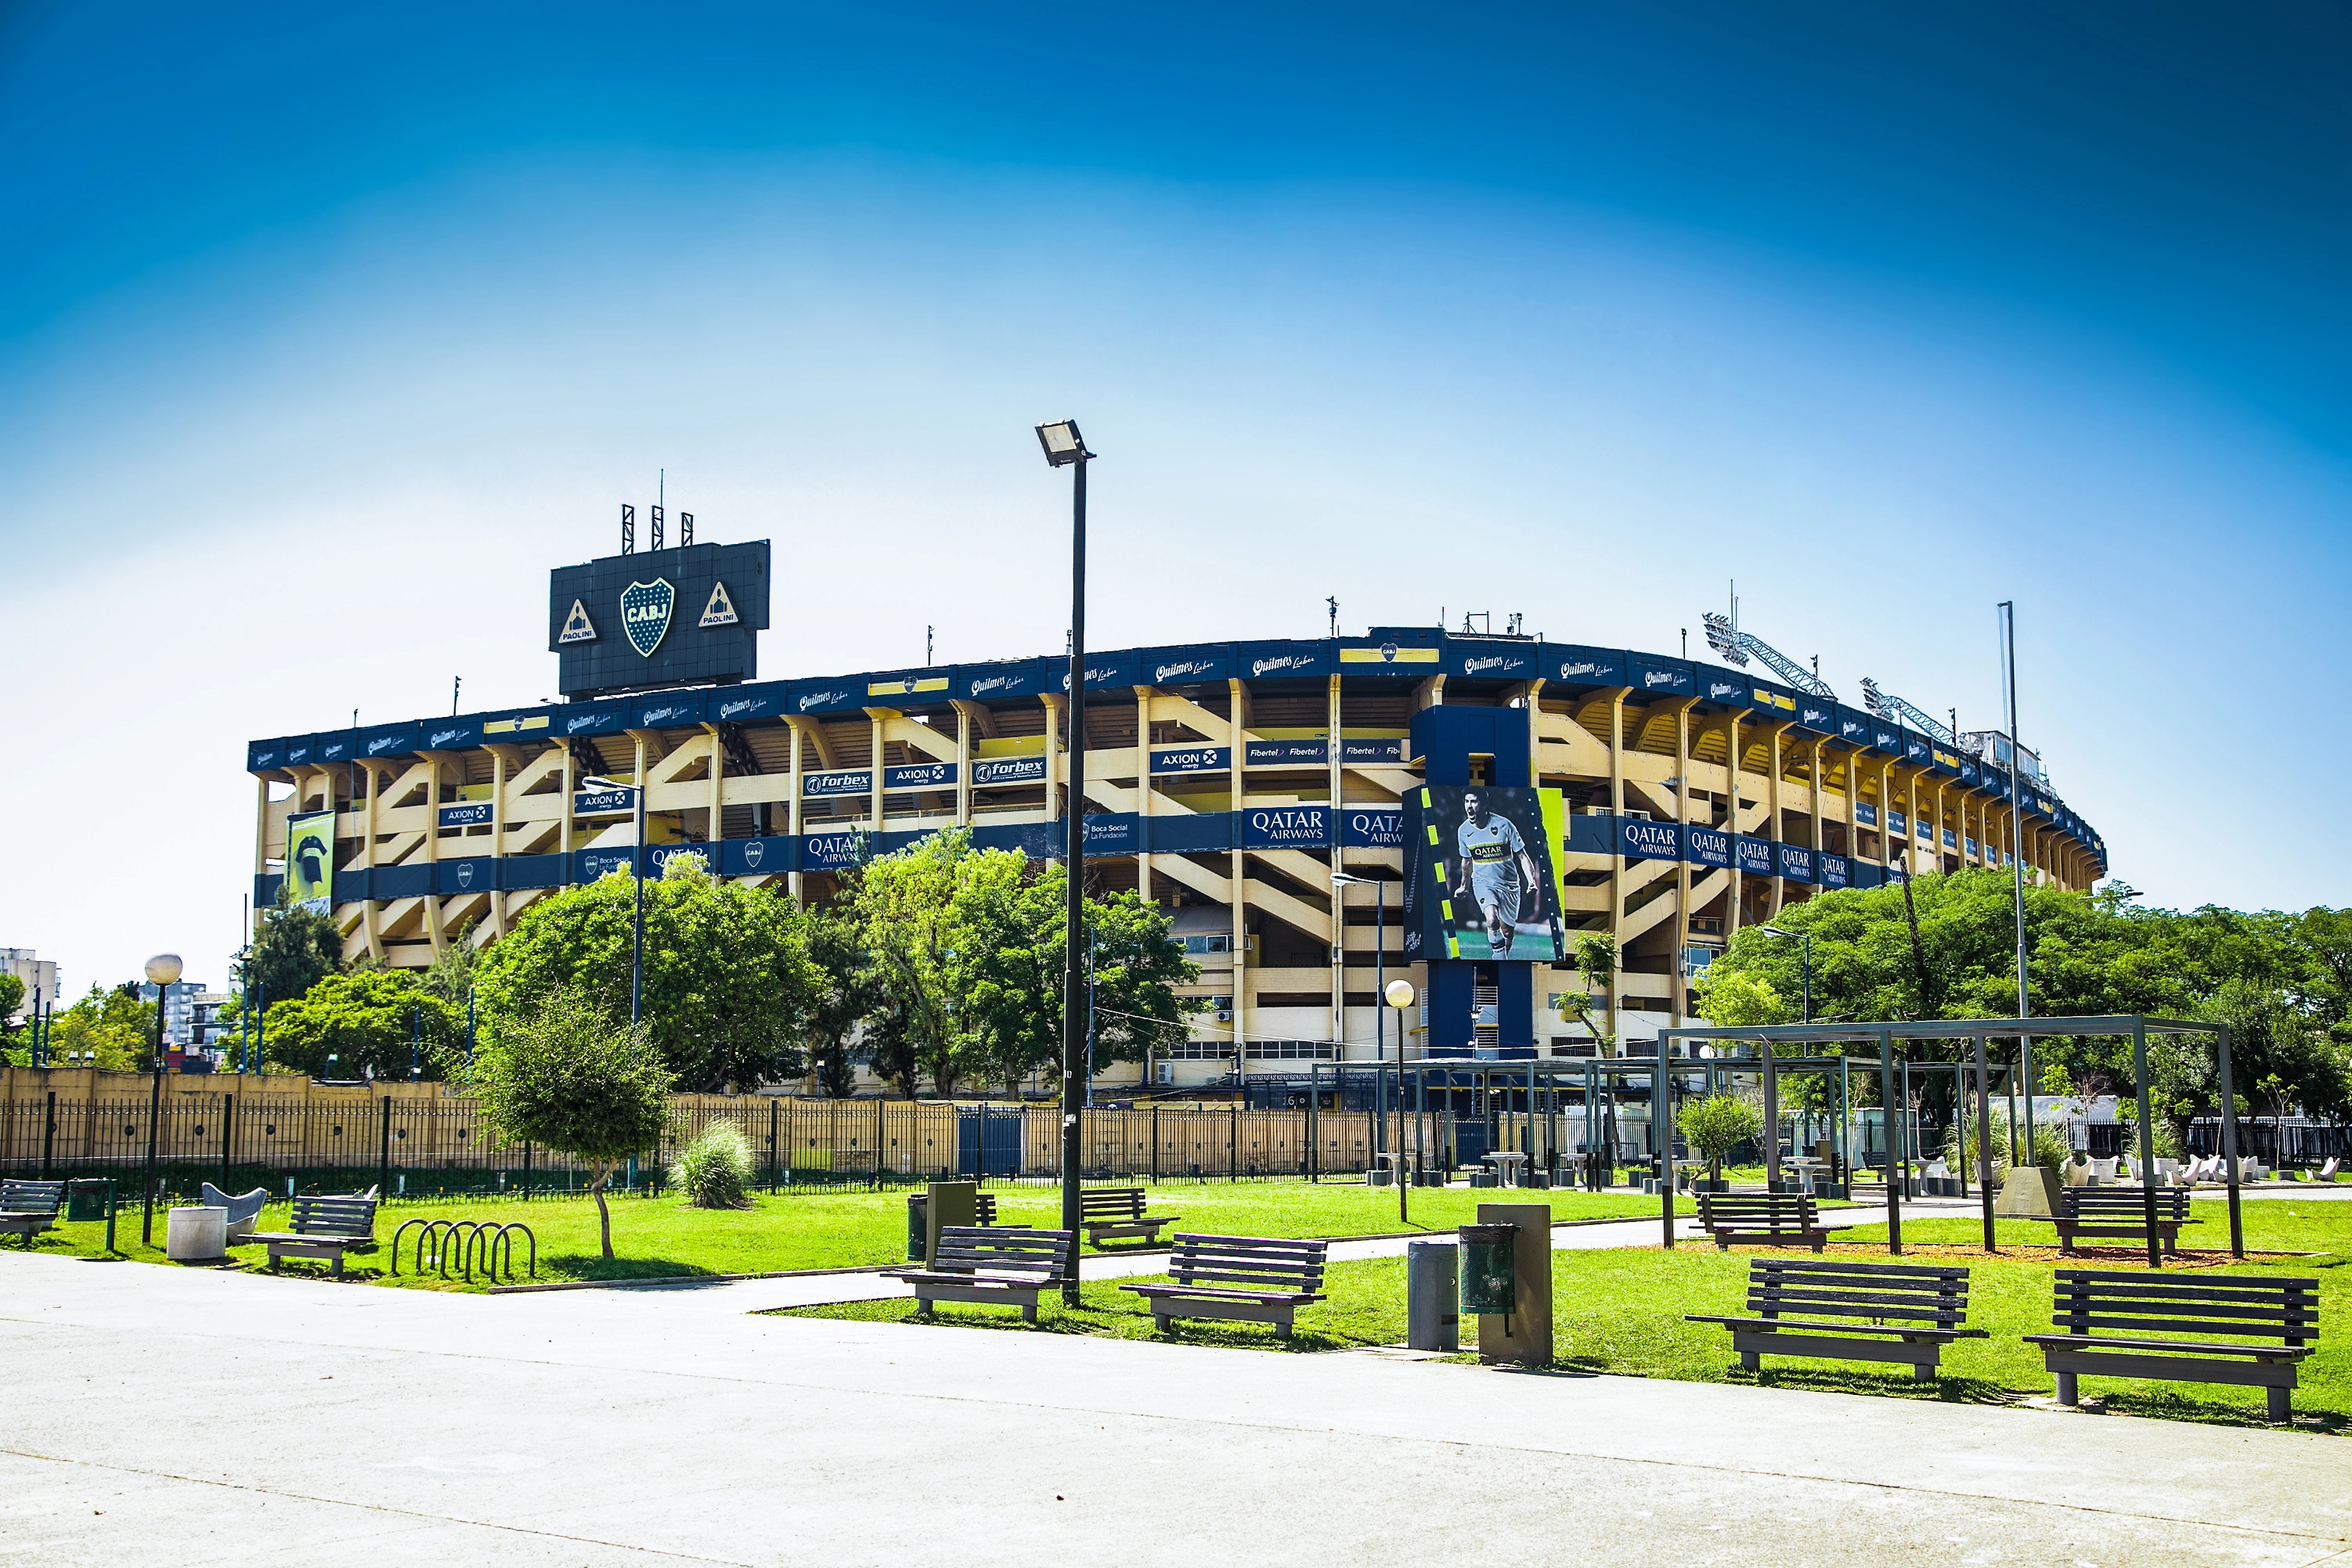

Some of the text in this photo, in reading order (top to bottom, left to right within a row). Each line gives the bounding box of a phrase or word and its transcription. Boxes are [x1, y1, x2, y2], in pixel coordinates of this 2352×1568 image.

[628, 604, 667, 622] CABJ
[703, 614, 734, 624] PAOLINI
[563, 630, 592, 640] PAOLINI
[1156, 661, 1214, 683] Quilmes Lieber
[1253, 655, 1315, 676] Quilmes Lieber
[1465, 656, 1524, 675] Quilmes Lieber
[1560, 662, 1613, 679] Quilmes Lieber
[1098, 668, 1116, 682] Lieber
[1645, 672, 1672, 687] Quilmes
[972, 676, 1024, 697] Quilmes Lieber
[1711, 683, 1731, 698] Quilmes
[799, 691, 831, 712] Quilmes
[720, 699, 750, 719] Quilmes
[644, 707, 672, 726] Quilmes
[568, 715, 595, 734] Quilmes
[1290, 748, 1318, 756] Fibertel
[1347, 747, 1375, 755] Fibertel
[1162, 754, 1199, 765] AXION
[896, 769, 929, 780] AXION
[992, 762, 1044, 774] forbex
[822, 774, 869, 786] forbex
[585, 795, 612, 806] AXION
[448, 809, 474, 820] AXION
[1253, 811, 1323, 832] QATAR
[1270, 828, 1323, 839] AIRWAYS
[1625, 825, 1676, 845] QATAR
[1692, 832, 1727, 853] QATAR
[1475, 846, 1502, 856] QATAR
[1640, 844, 1676, 856] AIRWAYS
[1739, 841, 1769, 861] QATAR
[1701, 851, 1727, 864] AIRWAYS
[1782, 849, 1809, 867] QATAR
[1747, 860, 1769, 871] AIRWAYS
[1790, 866, 1810, 877] AIRWAYS
